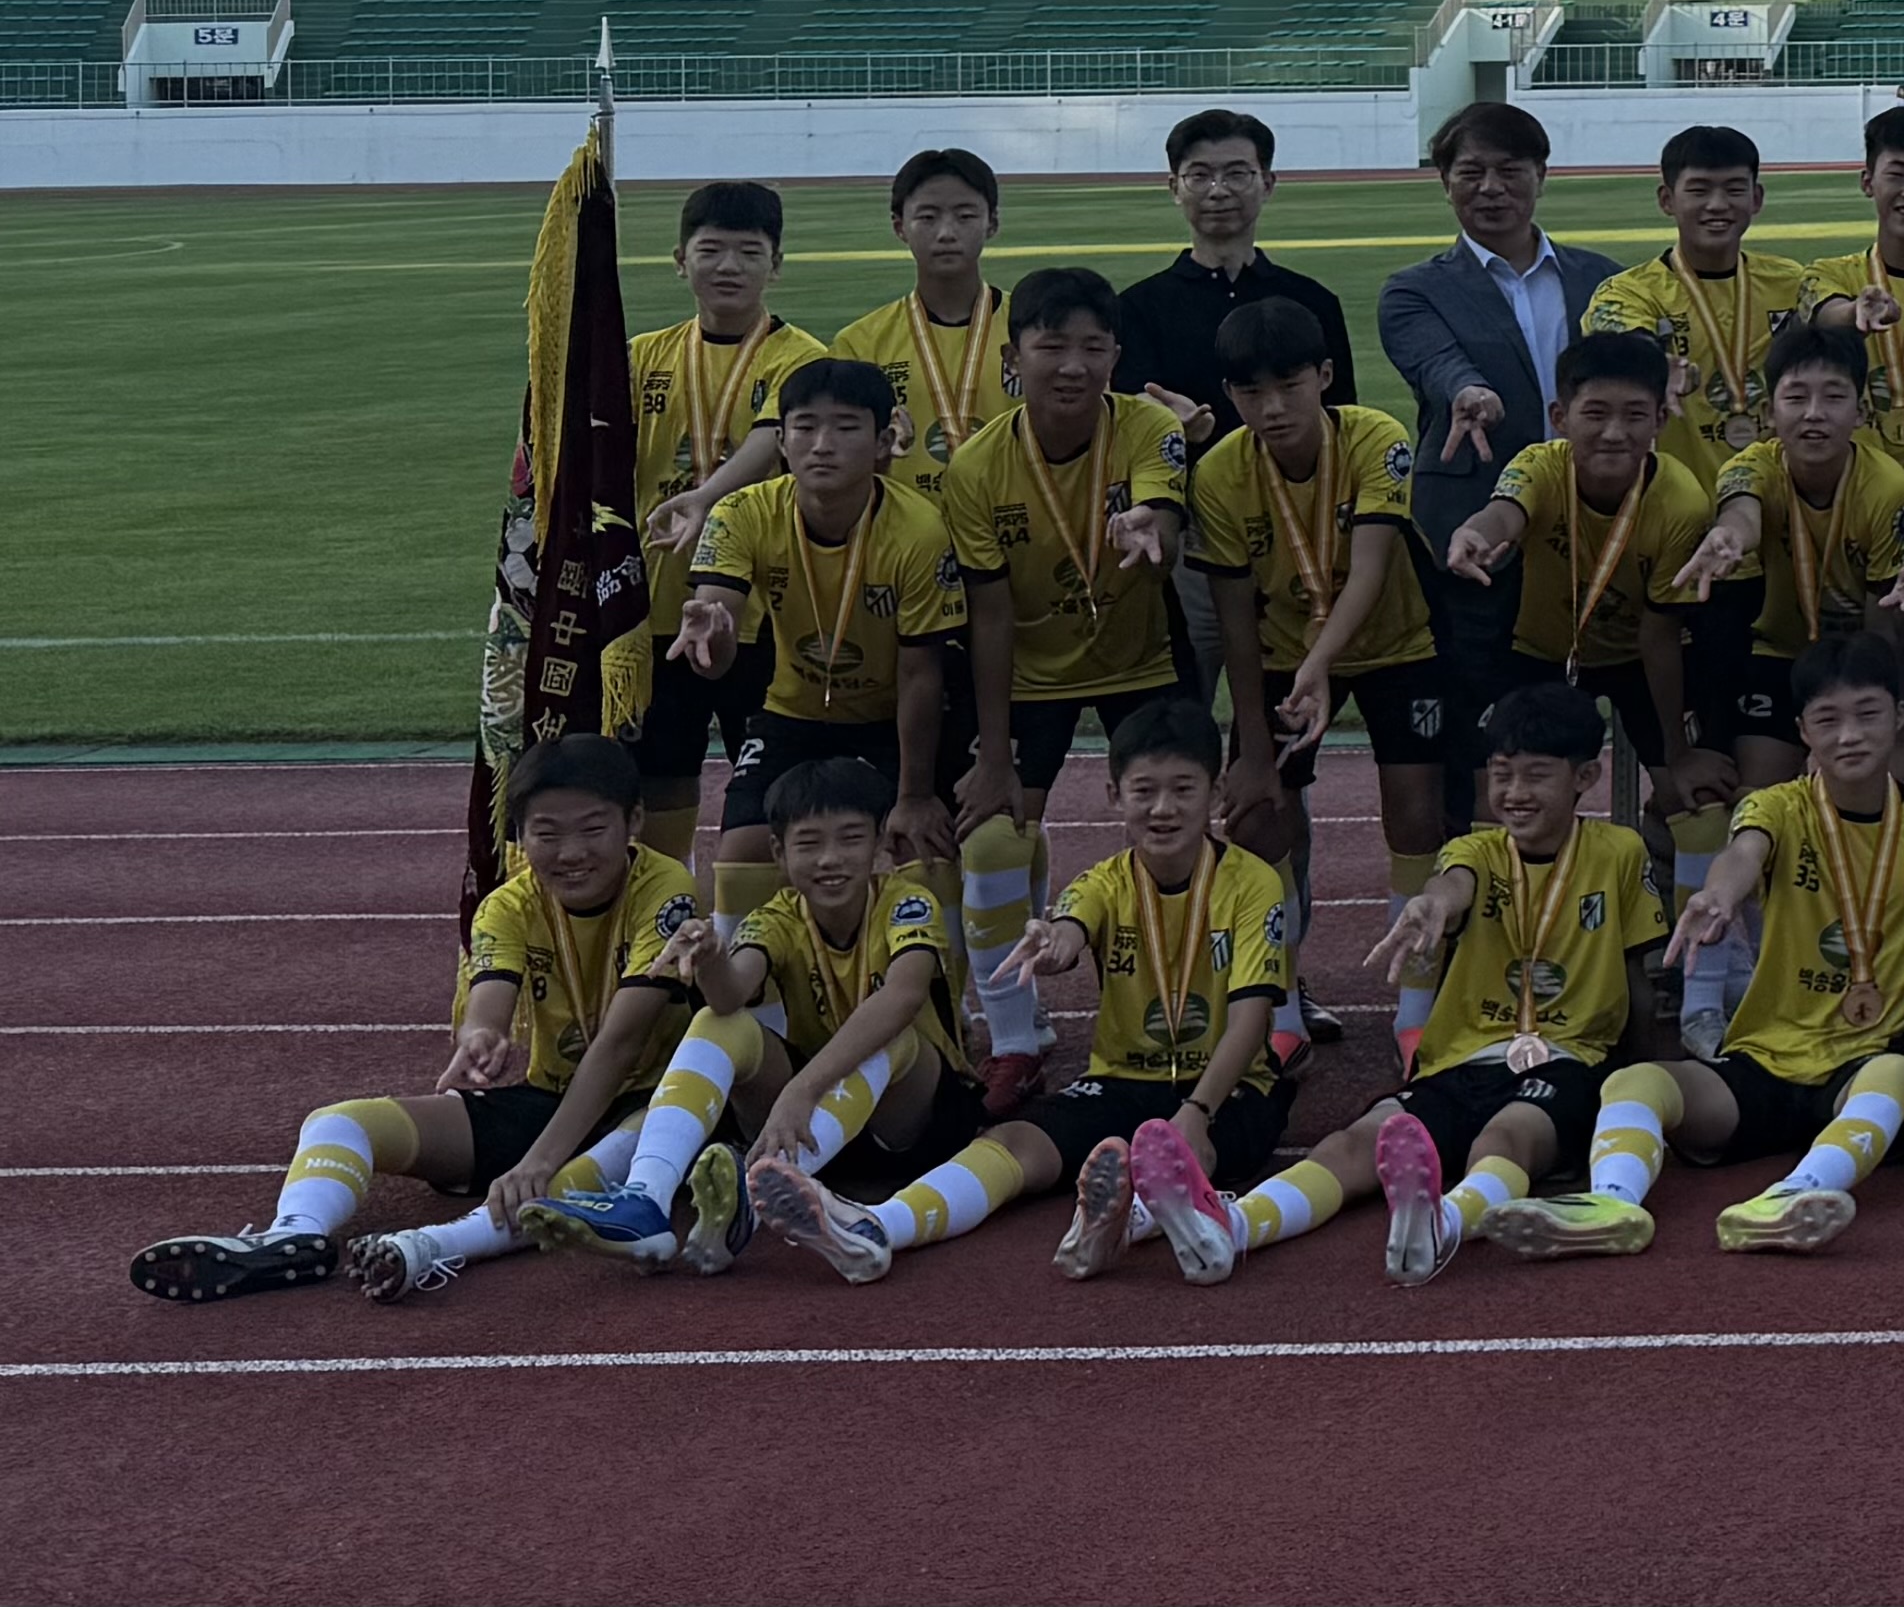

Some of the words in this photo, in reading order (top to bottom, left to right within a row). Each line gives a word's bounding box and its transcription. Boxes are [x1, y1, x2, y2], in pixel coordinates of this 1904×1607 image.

[644, 393, 666, 415] 38
[995, 513, 1029, 528] PSPS
[999, 527, 1030, 549] 44
[1107, 951, 1136, 976] 34
